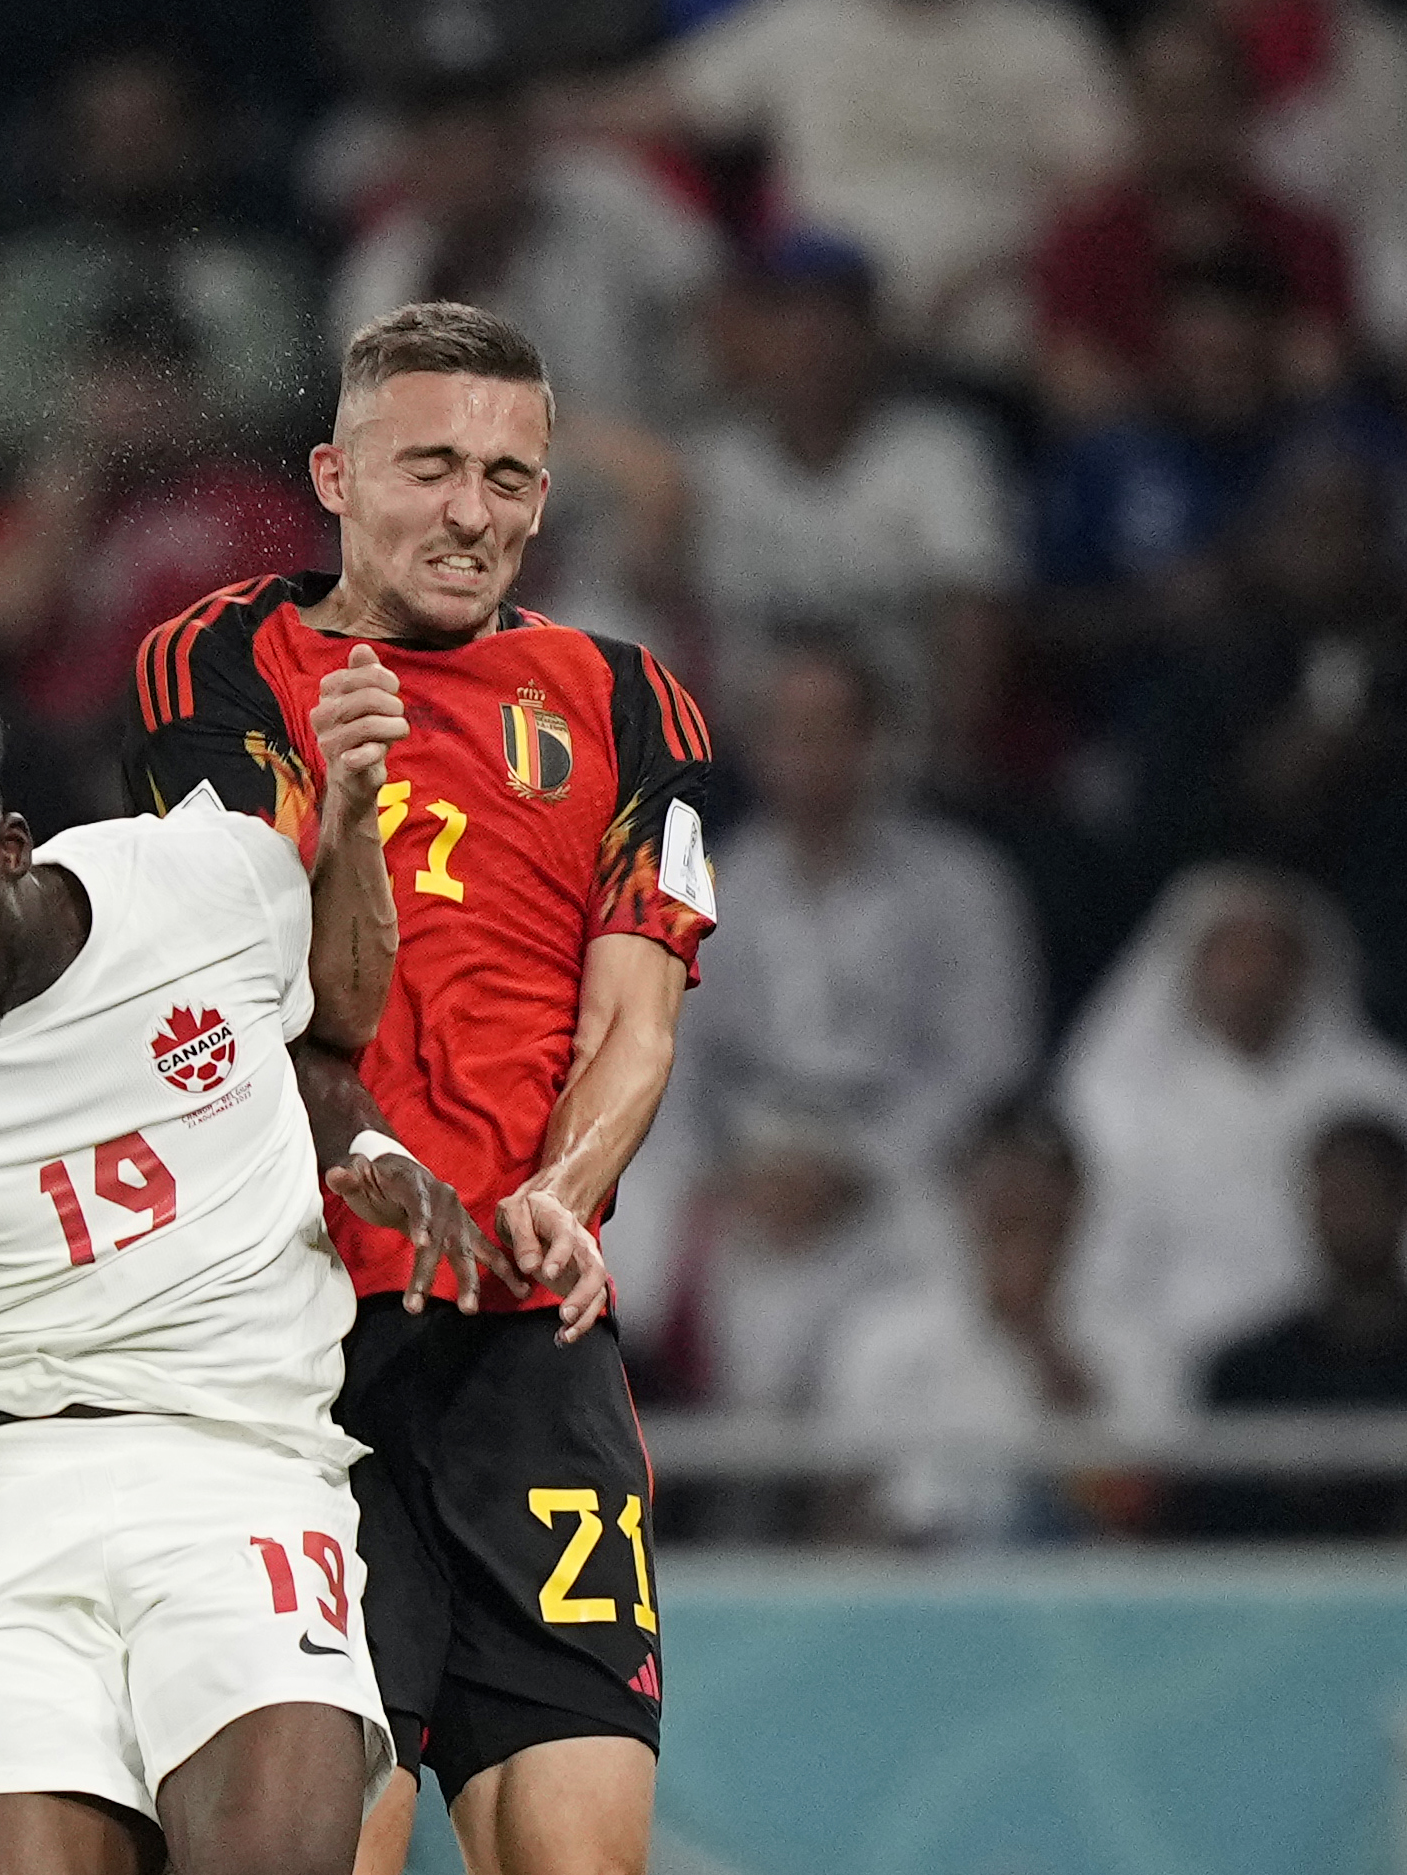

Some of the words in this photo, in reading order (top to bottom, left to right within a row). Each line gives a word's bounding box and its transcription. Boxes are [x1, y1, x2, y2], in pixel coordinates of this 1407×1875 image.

[157, 1025, 233, 1073] CANADA
[40, 1131, 176, 1266] 19
[250, 1530, 348, 1641] 19
[528, 1488, 657, 1635] 21
